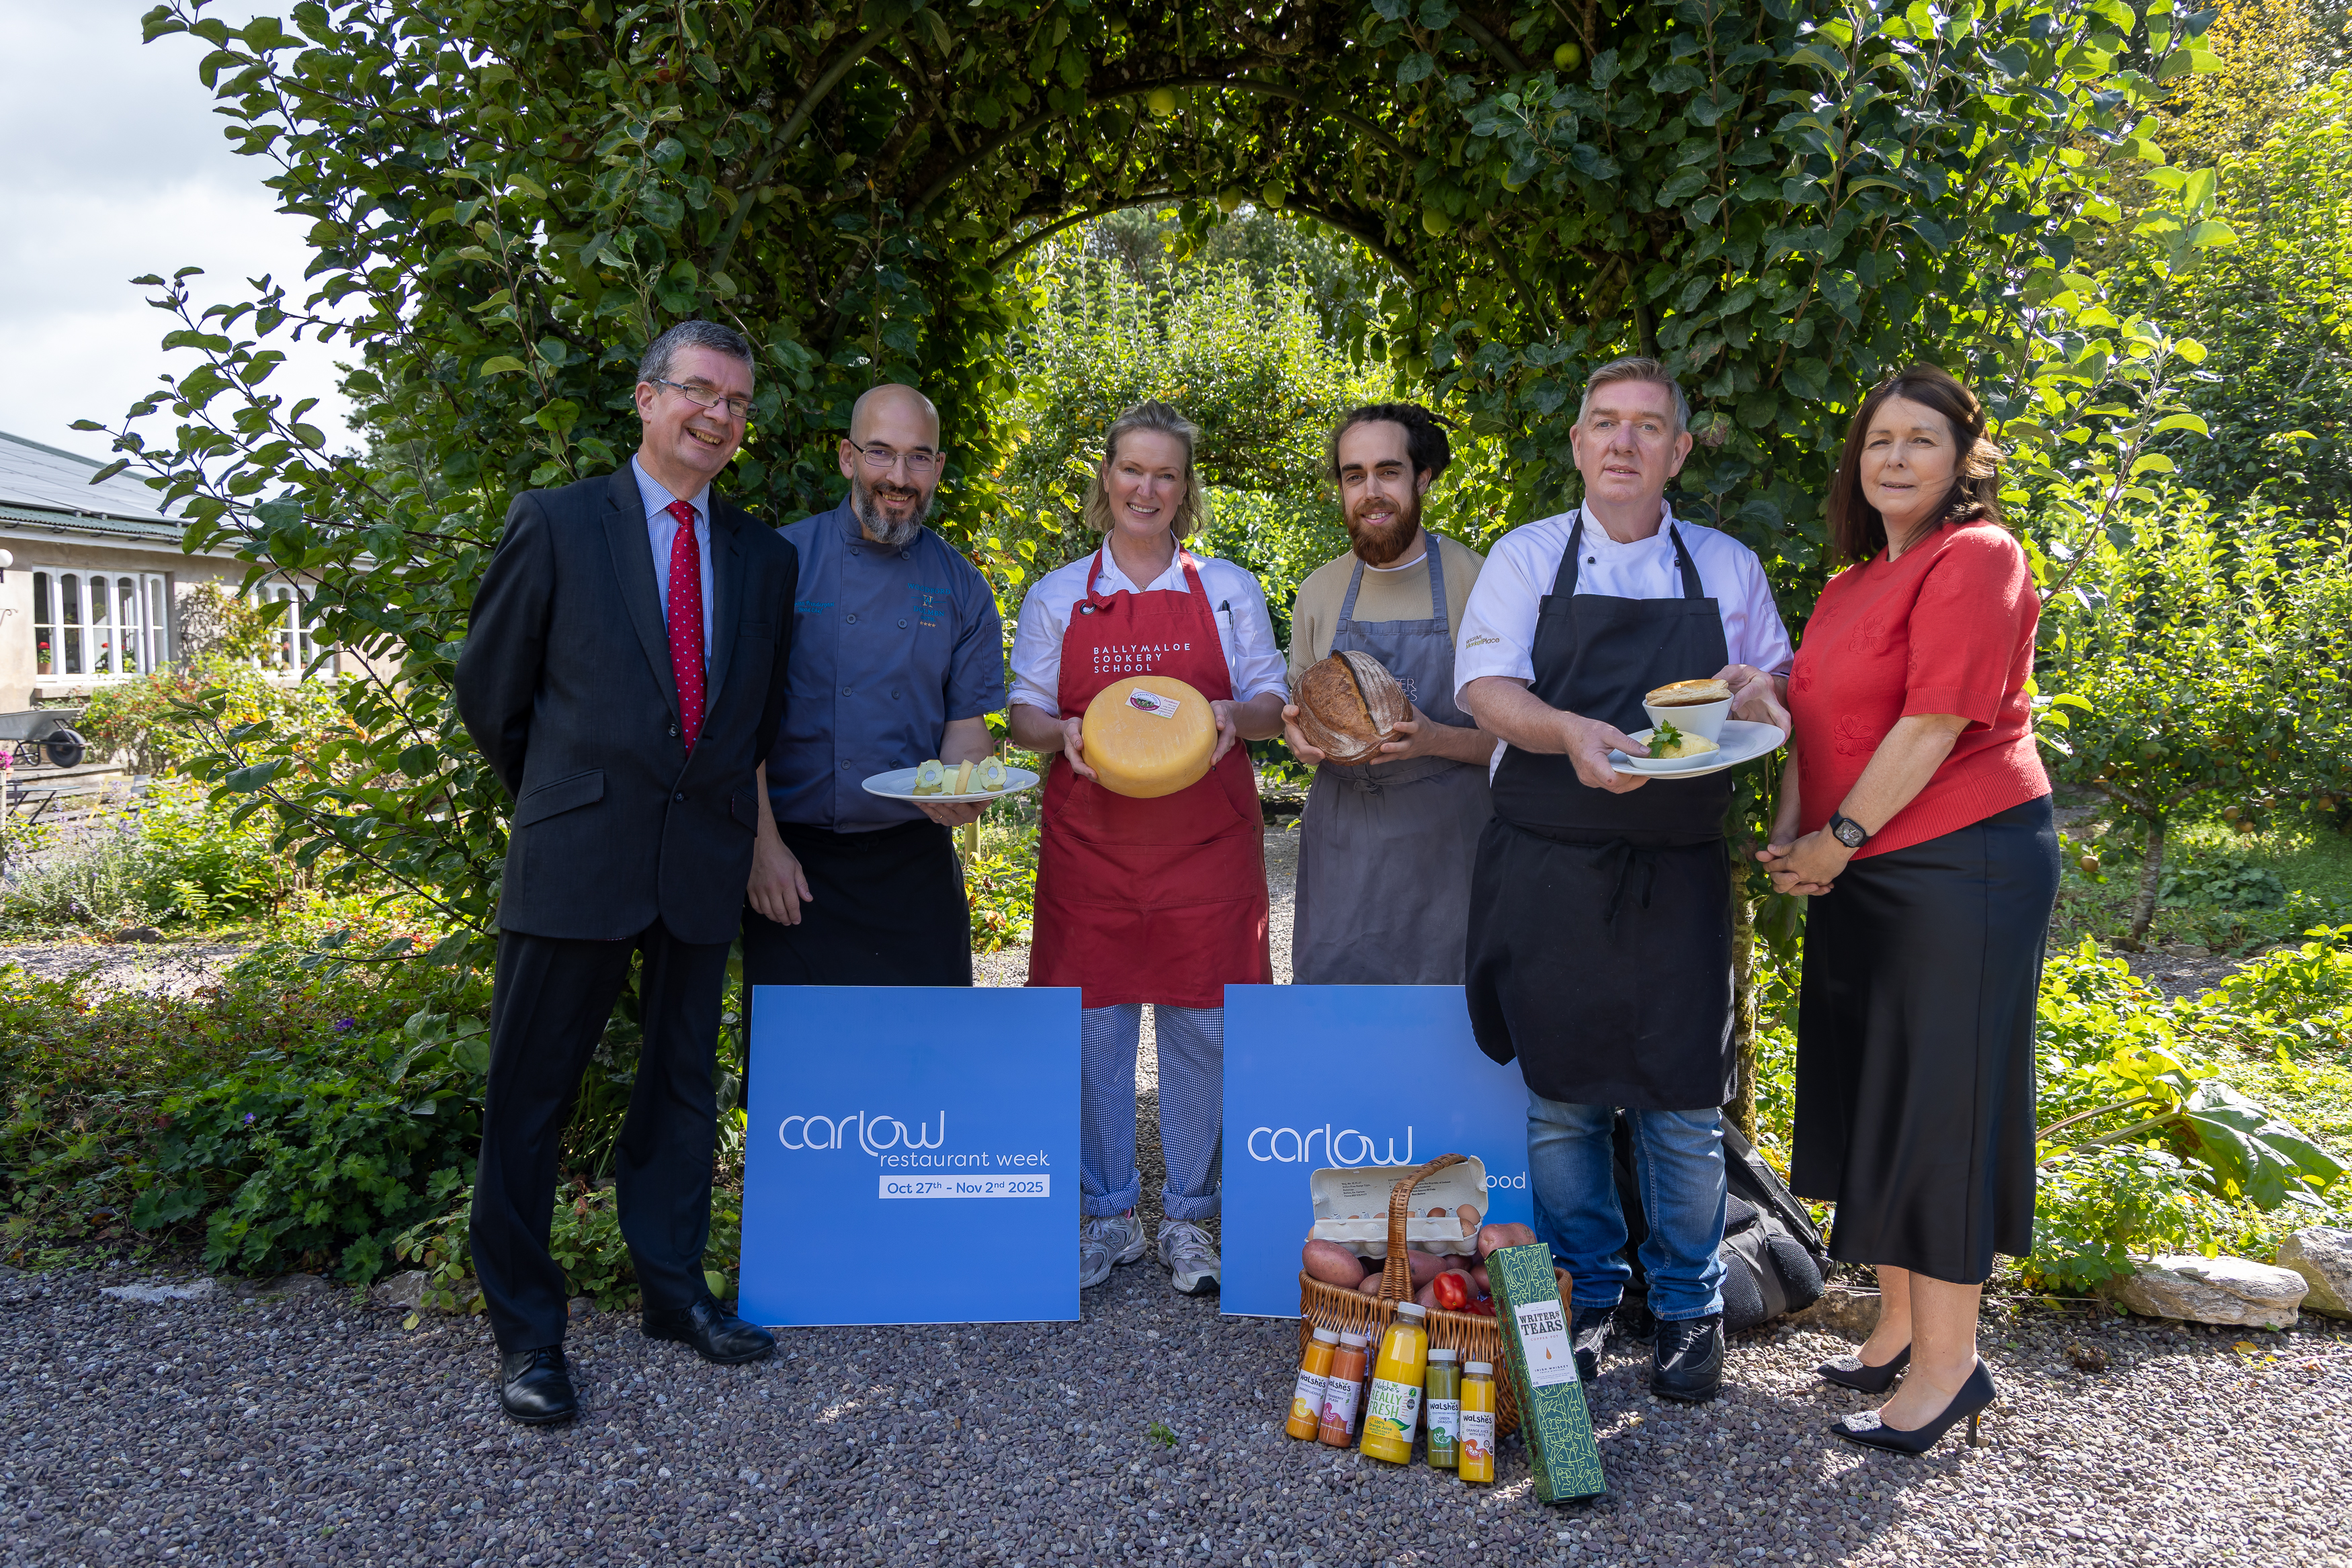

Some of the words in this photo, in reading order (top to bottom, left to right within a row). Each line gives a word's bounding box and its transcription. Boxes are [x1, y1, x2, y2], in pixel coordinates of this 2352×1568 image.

[908, 583, 951, 594] WOODFORD
[914, 606, 944, 616] DOLMEN
[1093, 643, 1191, 655] BALLYMALOE
[1094, 653, 1162, 663] COOKERY
[1094, 664, 1152, 673] SCHOOL
[1395, 678, 1417, 690] ER
[1404, 690, 1417, 701] ES
[779, 1110, 945, 1156] carlow
[1247, 1124, 1412, 1168] carlow
[880, 1151, 990, 1167] restaurant
[996, 1150, 1050, 1167] week
[1486, 1172, 1525, 1189] ood
[887, 1182, 912, 1194] Oct
[915, 1181, 942, 1194] 27th
[956, 1182, 983, 1194] Nov
[985, 1181, 1005, 1193] 2nd
[1008, 1181, 1043, 1193] 2025
[1521, 1319, 1563, 1336] TEARS
[1330, 1380, 1351, 1392] alshes
[1371, 1389, 1402, 1405] REALLY
[1369, 1400, 1399, 1418] FRESH
